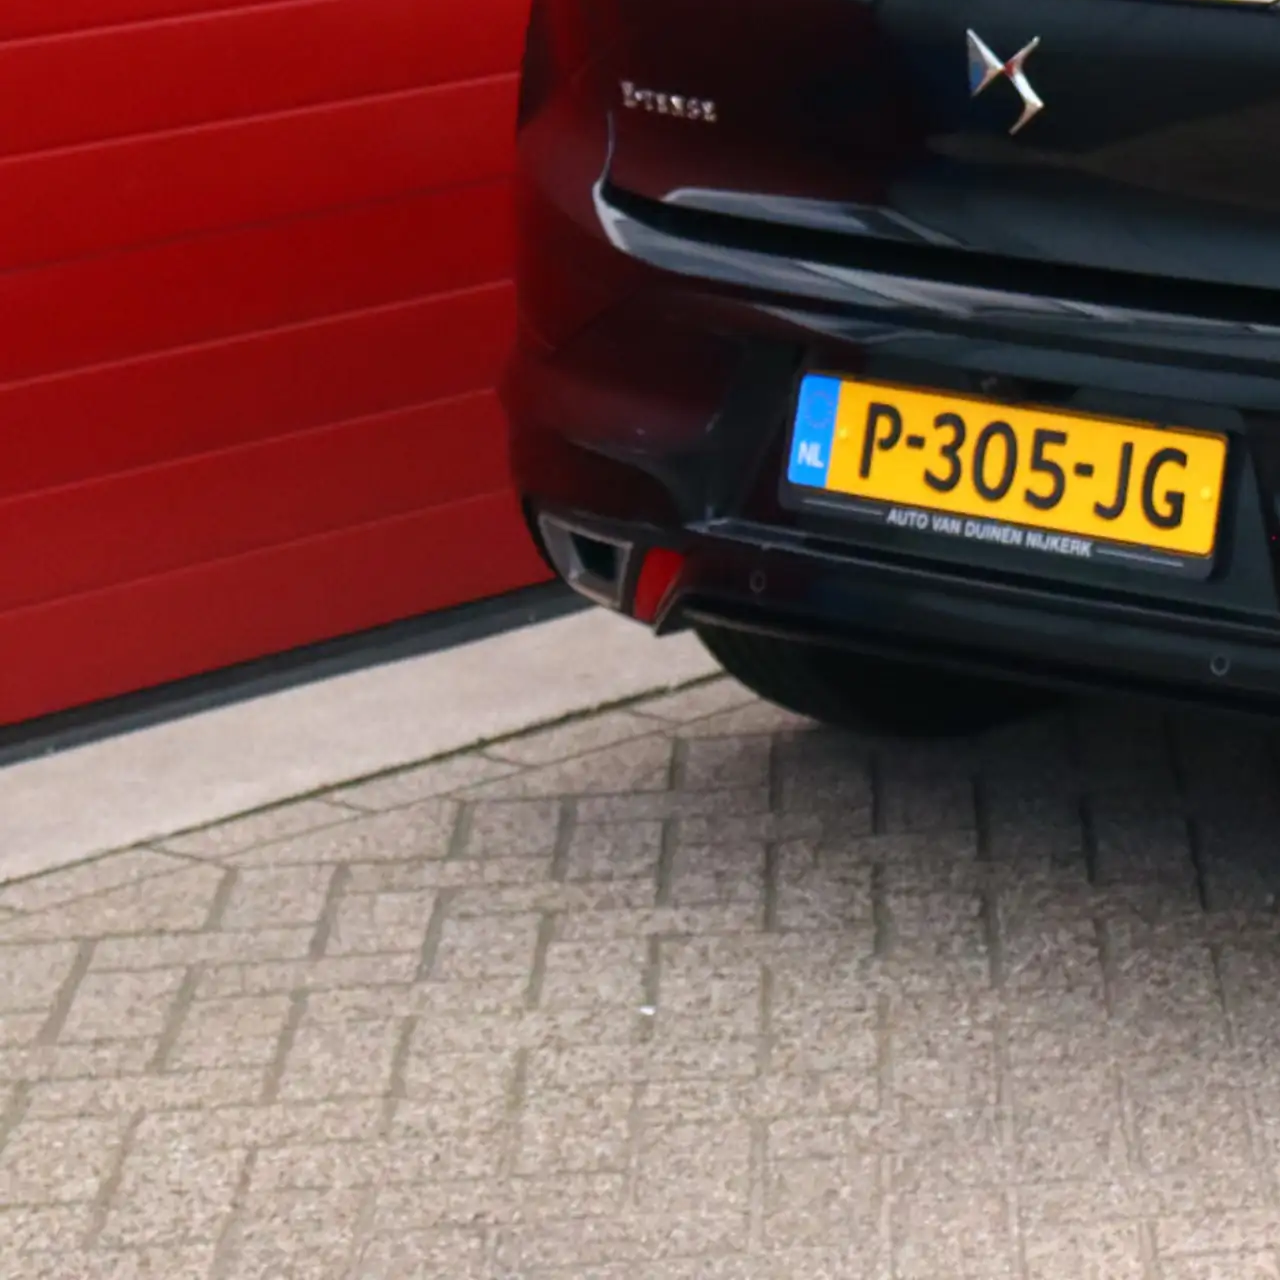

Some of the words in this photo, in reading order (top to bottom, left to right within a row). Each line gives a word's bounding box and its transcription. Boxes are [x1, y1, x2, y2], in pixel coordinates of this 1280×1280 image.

[798, 441, 824, 469] NL
[858, 401, 1189, 531] P-305-JG
[886, 507, 930, 530] AUTO
[932, 515, 962, 536] VAN
[964, 521, 1023, 547] DUINEN
[1025, 531, 1094, 559] NIJKERK
